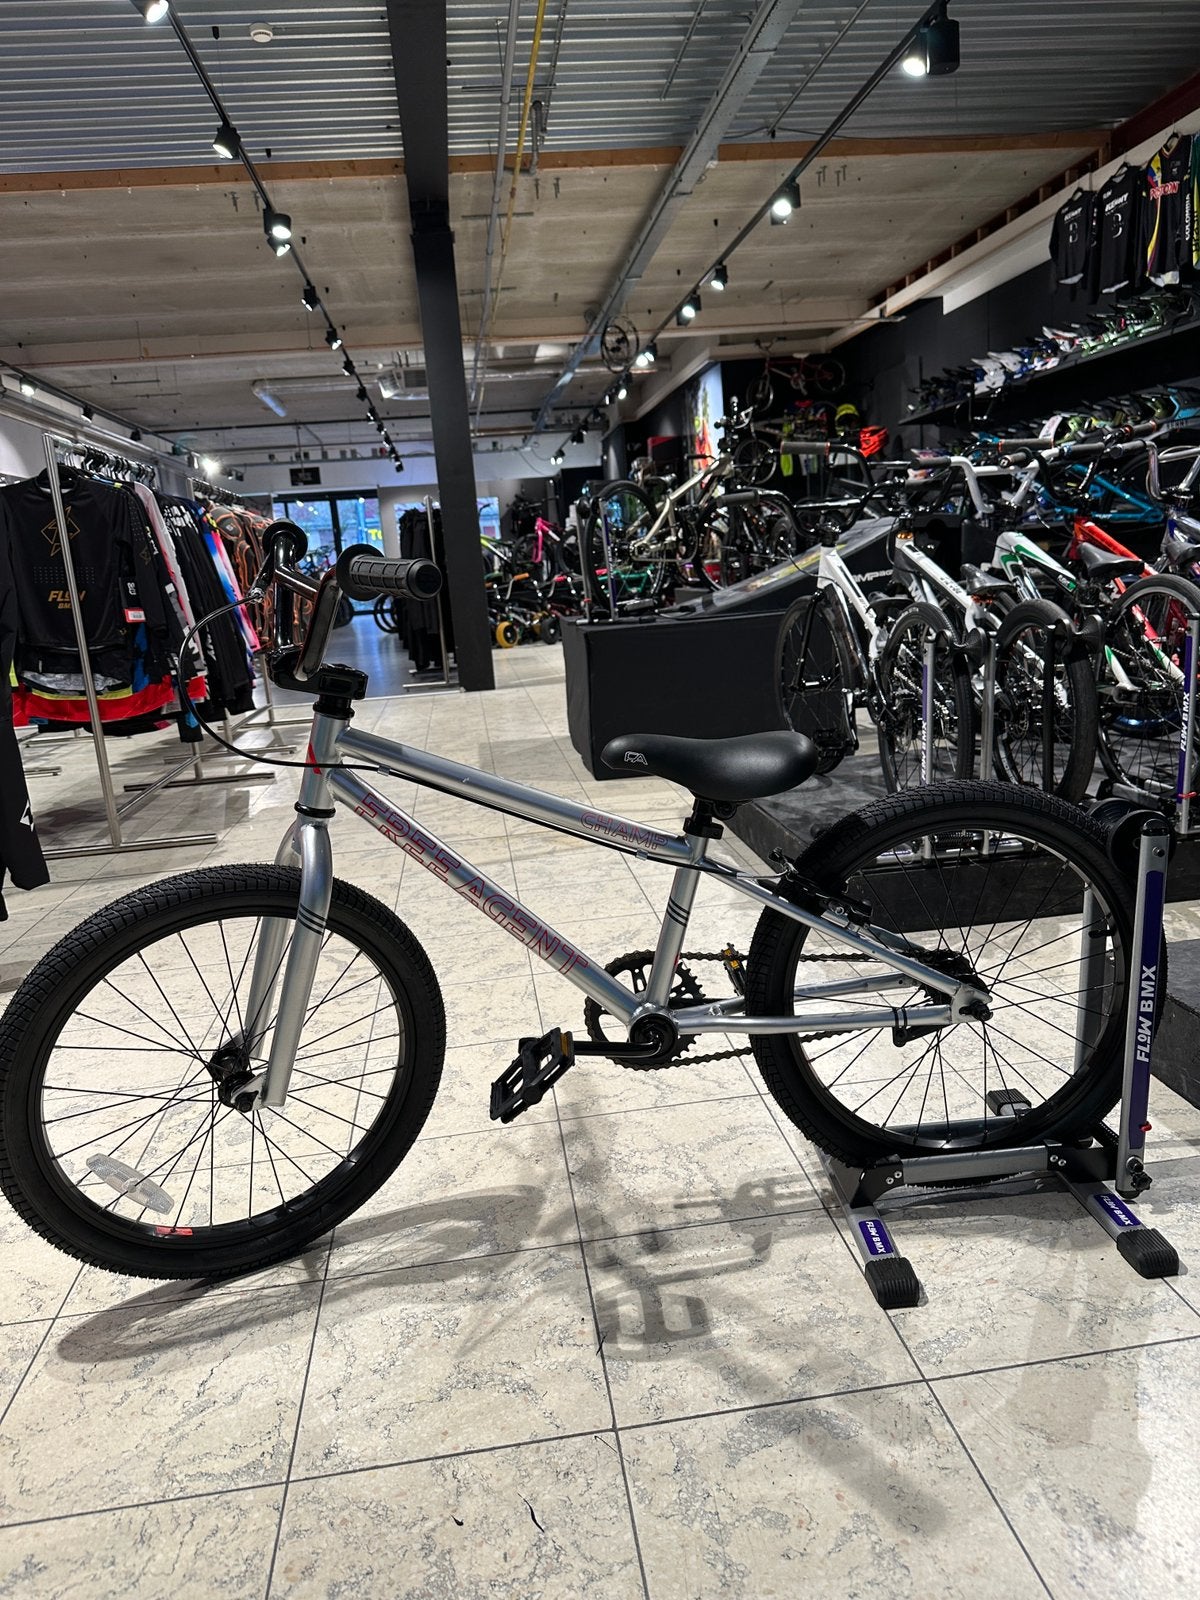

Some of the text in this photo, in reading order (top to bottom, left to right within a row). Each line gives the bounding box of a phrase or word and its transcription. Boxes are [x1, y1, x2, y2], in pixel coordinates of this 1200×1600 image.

[1182, 691, 1190, 722] BMX
[580, 811, 669, 851] CHAMP
[354, 792, 590, 976] FREE AGENT
[1140, 964, 1157, 1012] BMX
[1113, 1209, 1134, 1226] BMX
[872, 1236, 887, 1254] BMX
